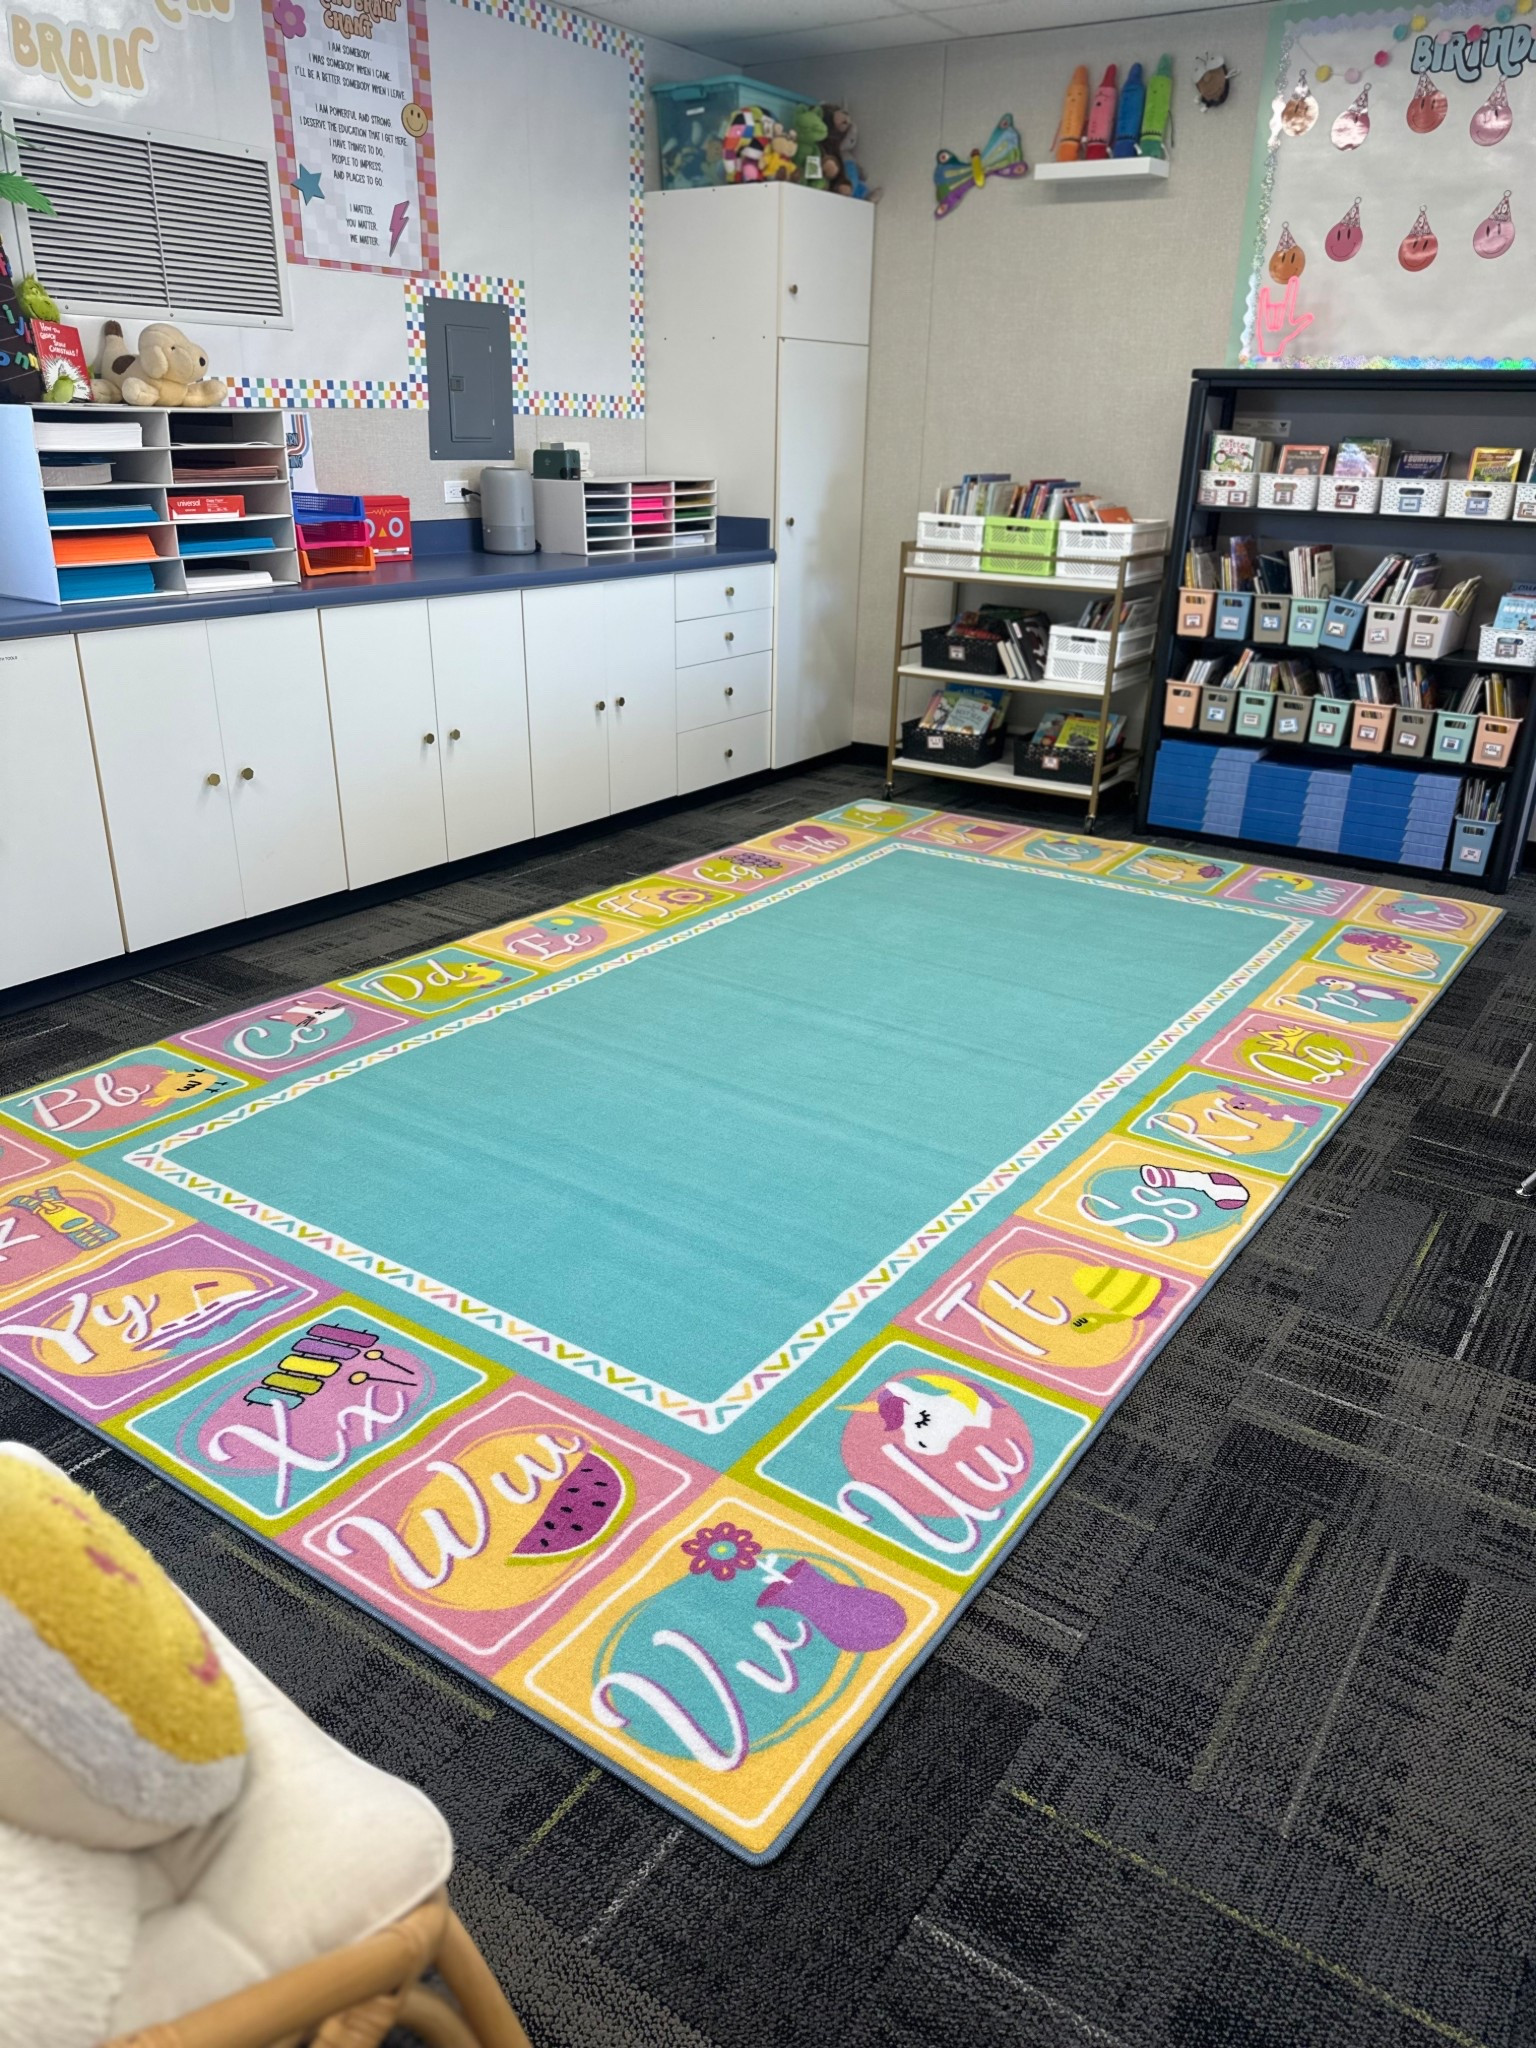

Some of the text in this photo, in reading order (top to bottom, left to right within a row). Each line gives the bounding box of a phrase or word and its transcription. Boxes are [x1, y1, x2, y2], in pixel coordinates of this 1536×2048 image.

[323, 9, 373, 39] CHANT
[10, 13, 155, 99] BRAIN
[312, 53, 325, 66] WAS
[326, 57, 355, 72] SOMEBODY
[356, 64, 371, 77] WHEN
[332, 42, 341, 53] AM
[342, 44, 372, 61] SOMEBODY.
[1411, 24, 1536, 83] BIRTHD
[307, 68, 315, 79] BE
[316, 70, 321, 80] A
[322, 71, 341, 85] BETTER
[342, 77, 370, 92] SOMEBODY
[372, 84, 386, 96] WHEN
[319, 103, 329, 115] AM
[329, 105, 357, 121] POWERFUL
[358, 112, 370, 123] AND
[303, 116, 326, 130] DESERVE
[327, 121, 338, 132] THE
[338, 123, 367, 138] EDUCATION
[368, 130, 380, 141] THAT
[384, 133, 394, 144] GET
[331, 153, 351, 167] PEOPLE
[352, 157, 359, 168] TO
[333, 139, 347, 150] HAVE
[347, 140, 367, 154] THINGS
[367, 145, 375, 155] TO
[333, 169, 345, 180] AND
[345, 171, 366, 184] PLACES
[366, 175, 374, 186] TO
[345, 217, 357, 229] YOU
[350, 233, 359, 244] WE
[176, 499, 201, 507] universal
[778, 835, 849, 860] Hh
[692, 864, 765, 886] Gg
[596, 889, 671, 918] Ff
[507, 930, 594, 962] Ee
[361, 958, 470, 1003] Dd
[1275, 990, 1382, 1024] Pp
[232, 1023, 330, 1061] Cc
[1249, 1045, 1371, 1085] Qq
[19, 1072, 152, 1133] Bb
[1146, 1097, 1261, 1157] Rr
[1076, 1185, 1202, 1248] Ss
[0, 1292, 160, 1365] Yy
[935, 1278, 1072, 1356] Tt
[208, 1387, 407, 1509] Xx
[326, 1432, 587, 1591] Ww
[837, 1437, 1030, 1555] Uu
[590, 1618, 812, 1773] Vv
